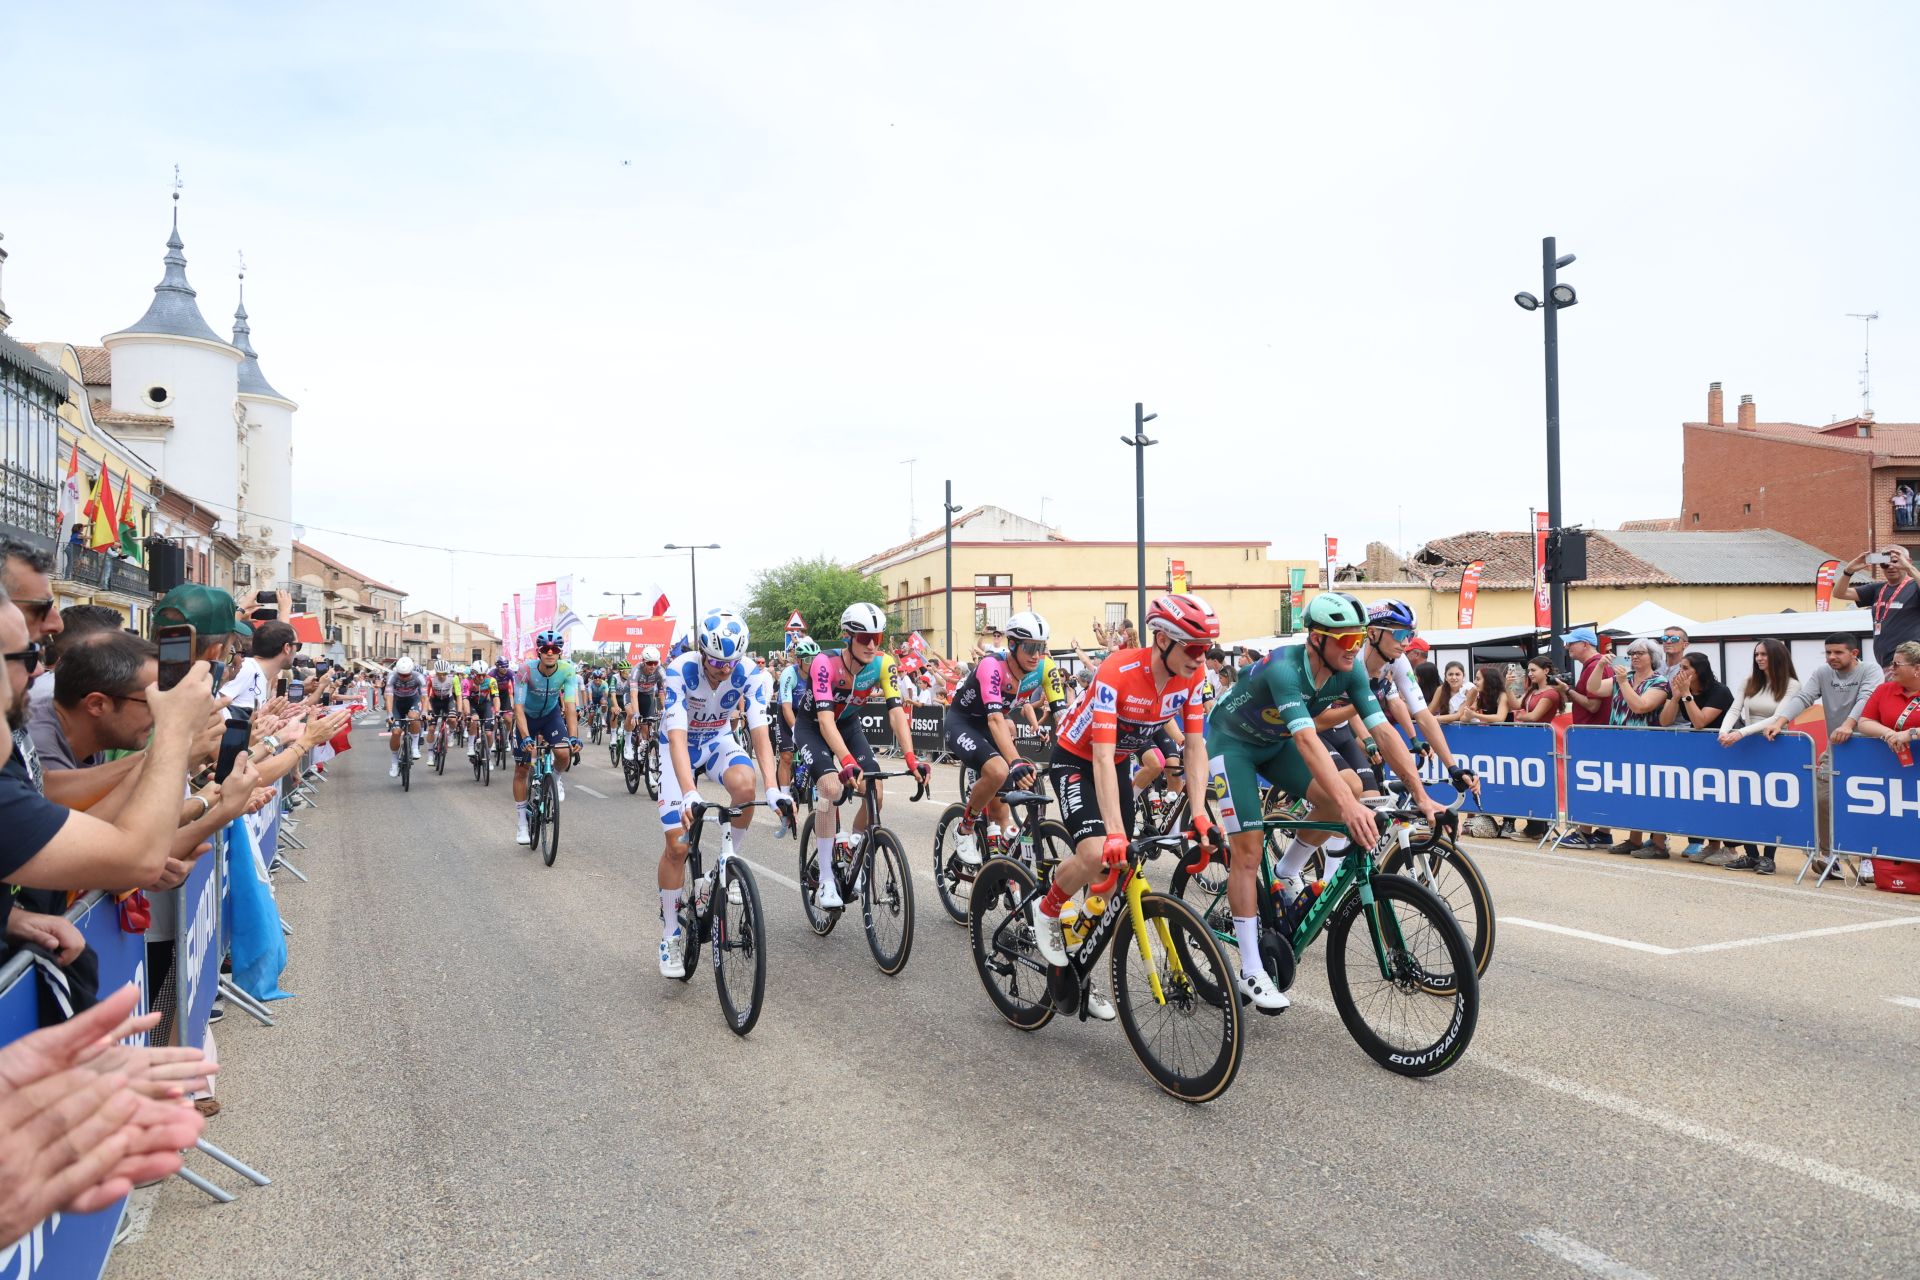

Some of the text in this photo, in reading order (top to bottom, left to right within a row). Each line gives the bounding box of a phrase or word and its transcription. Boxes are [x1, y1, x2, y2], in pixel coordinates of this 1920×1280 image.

[1460, 608, 1472, 625] WC
[1125, 695, 1154, 706] Santini
[1278, 701, 1301, 713] Santini
[693, 710, 730, 722] UAE
[957, 732, 978, 752] lotto
[1575, 759, 1800, 809] SHIMANO
[1067, 782, 1084, 814] VISMA
[1017, 956, 1040, 971] SRAM
[1388, 992, 1465, 1066] BONTRAGER
